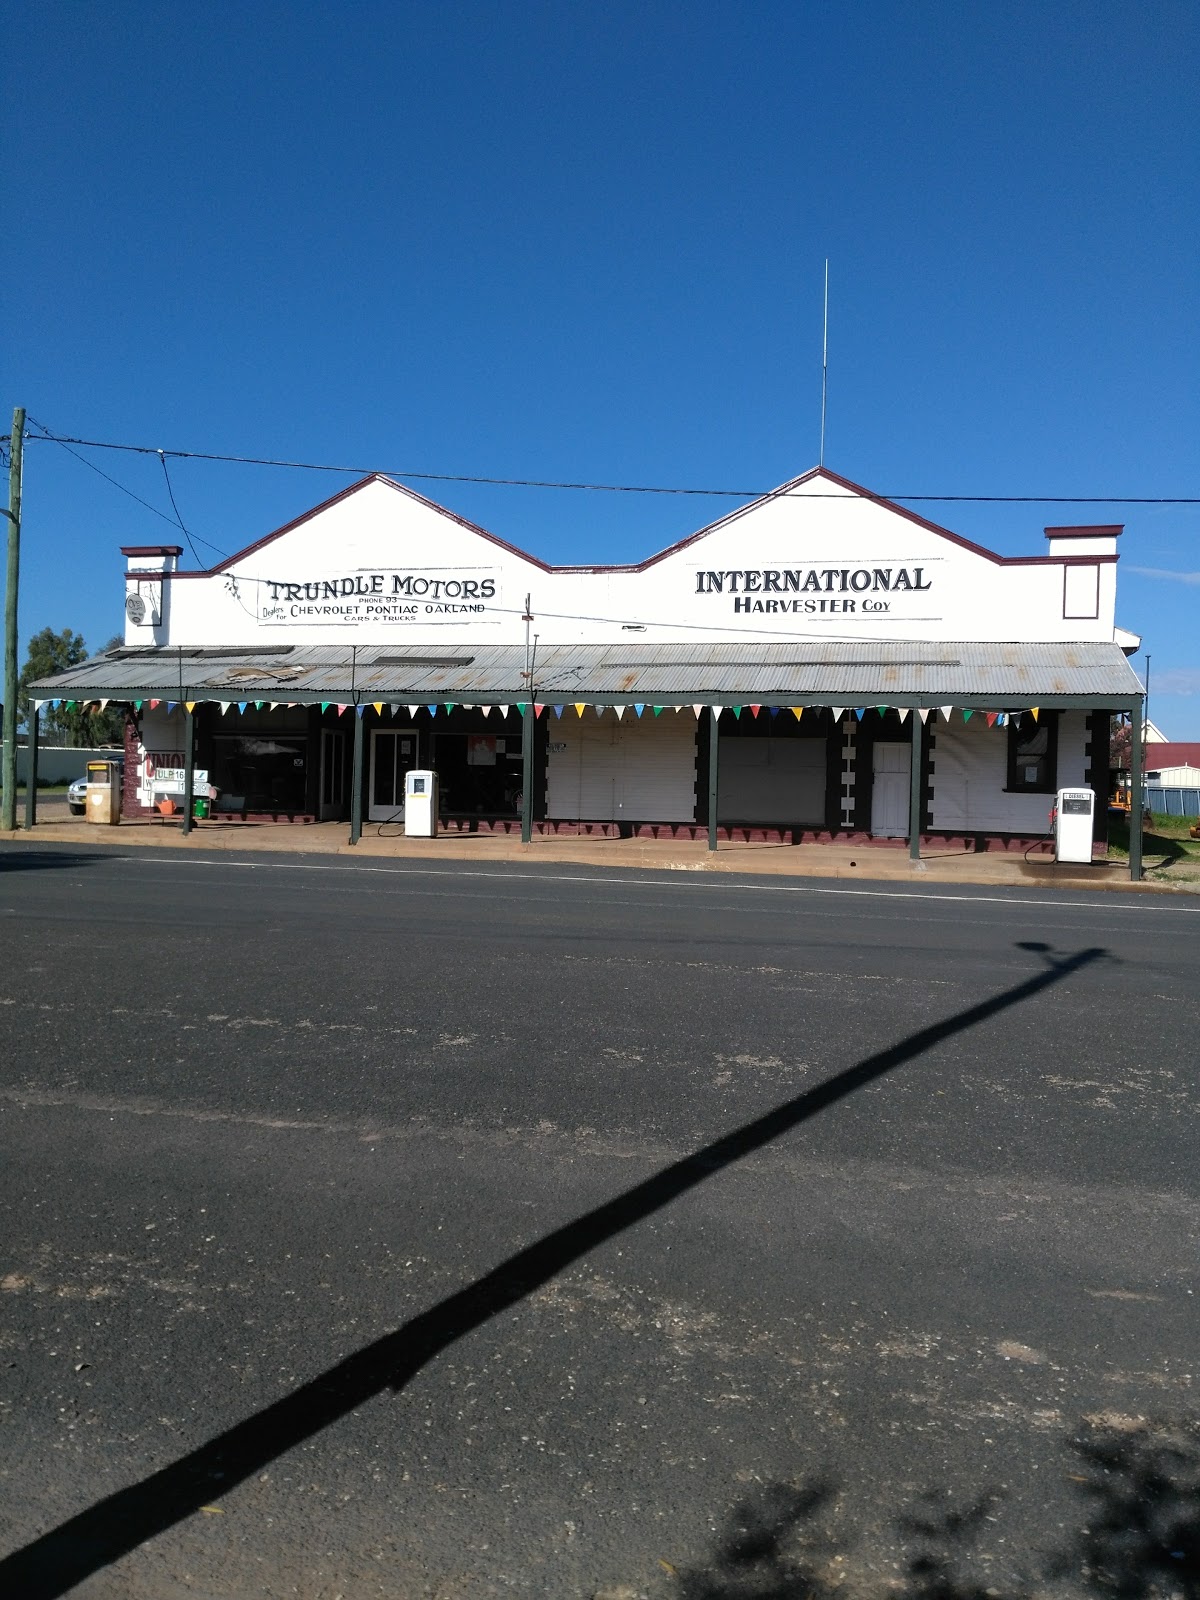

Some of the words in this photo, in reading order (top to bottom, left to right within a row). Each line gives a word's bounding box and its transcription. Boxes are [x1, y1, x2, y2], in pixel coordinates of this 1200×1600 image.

[695, 568, 932, 593] INTERNATIONAL
[266, 575, 385, 601] TRUNDLE
[391, 575, 496, 599] MOTORS
[290, 605, 360, 617] CHEVROLET
[366, 605, 418, 614] PONTIAC
[425, 604, 485, 613] OAKLAND
[734, 597, 856, 613] HARVESTER
[262, 607, 284, 618] Dealers
[158, 770, 174, 779] ULP
